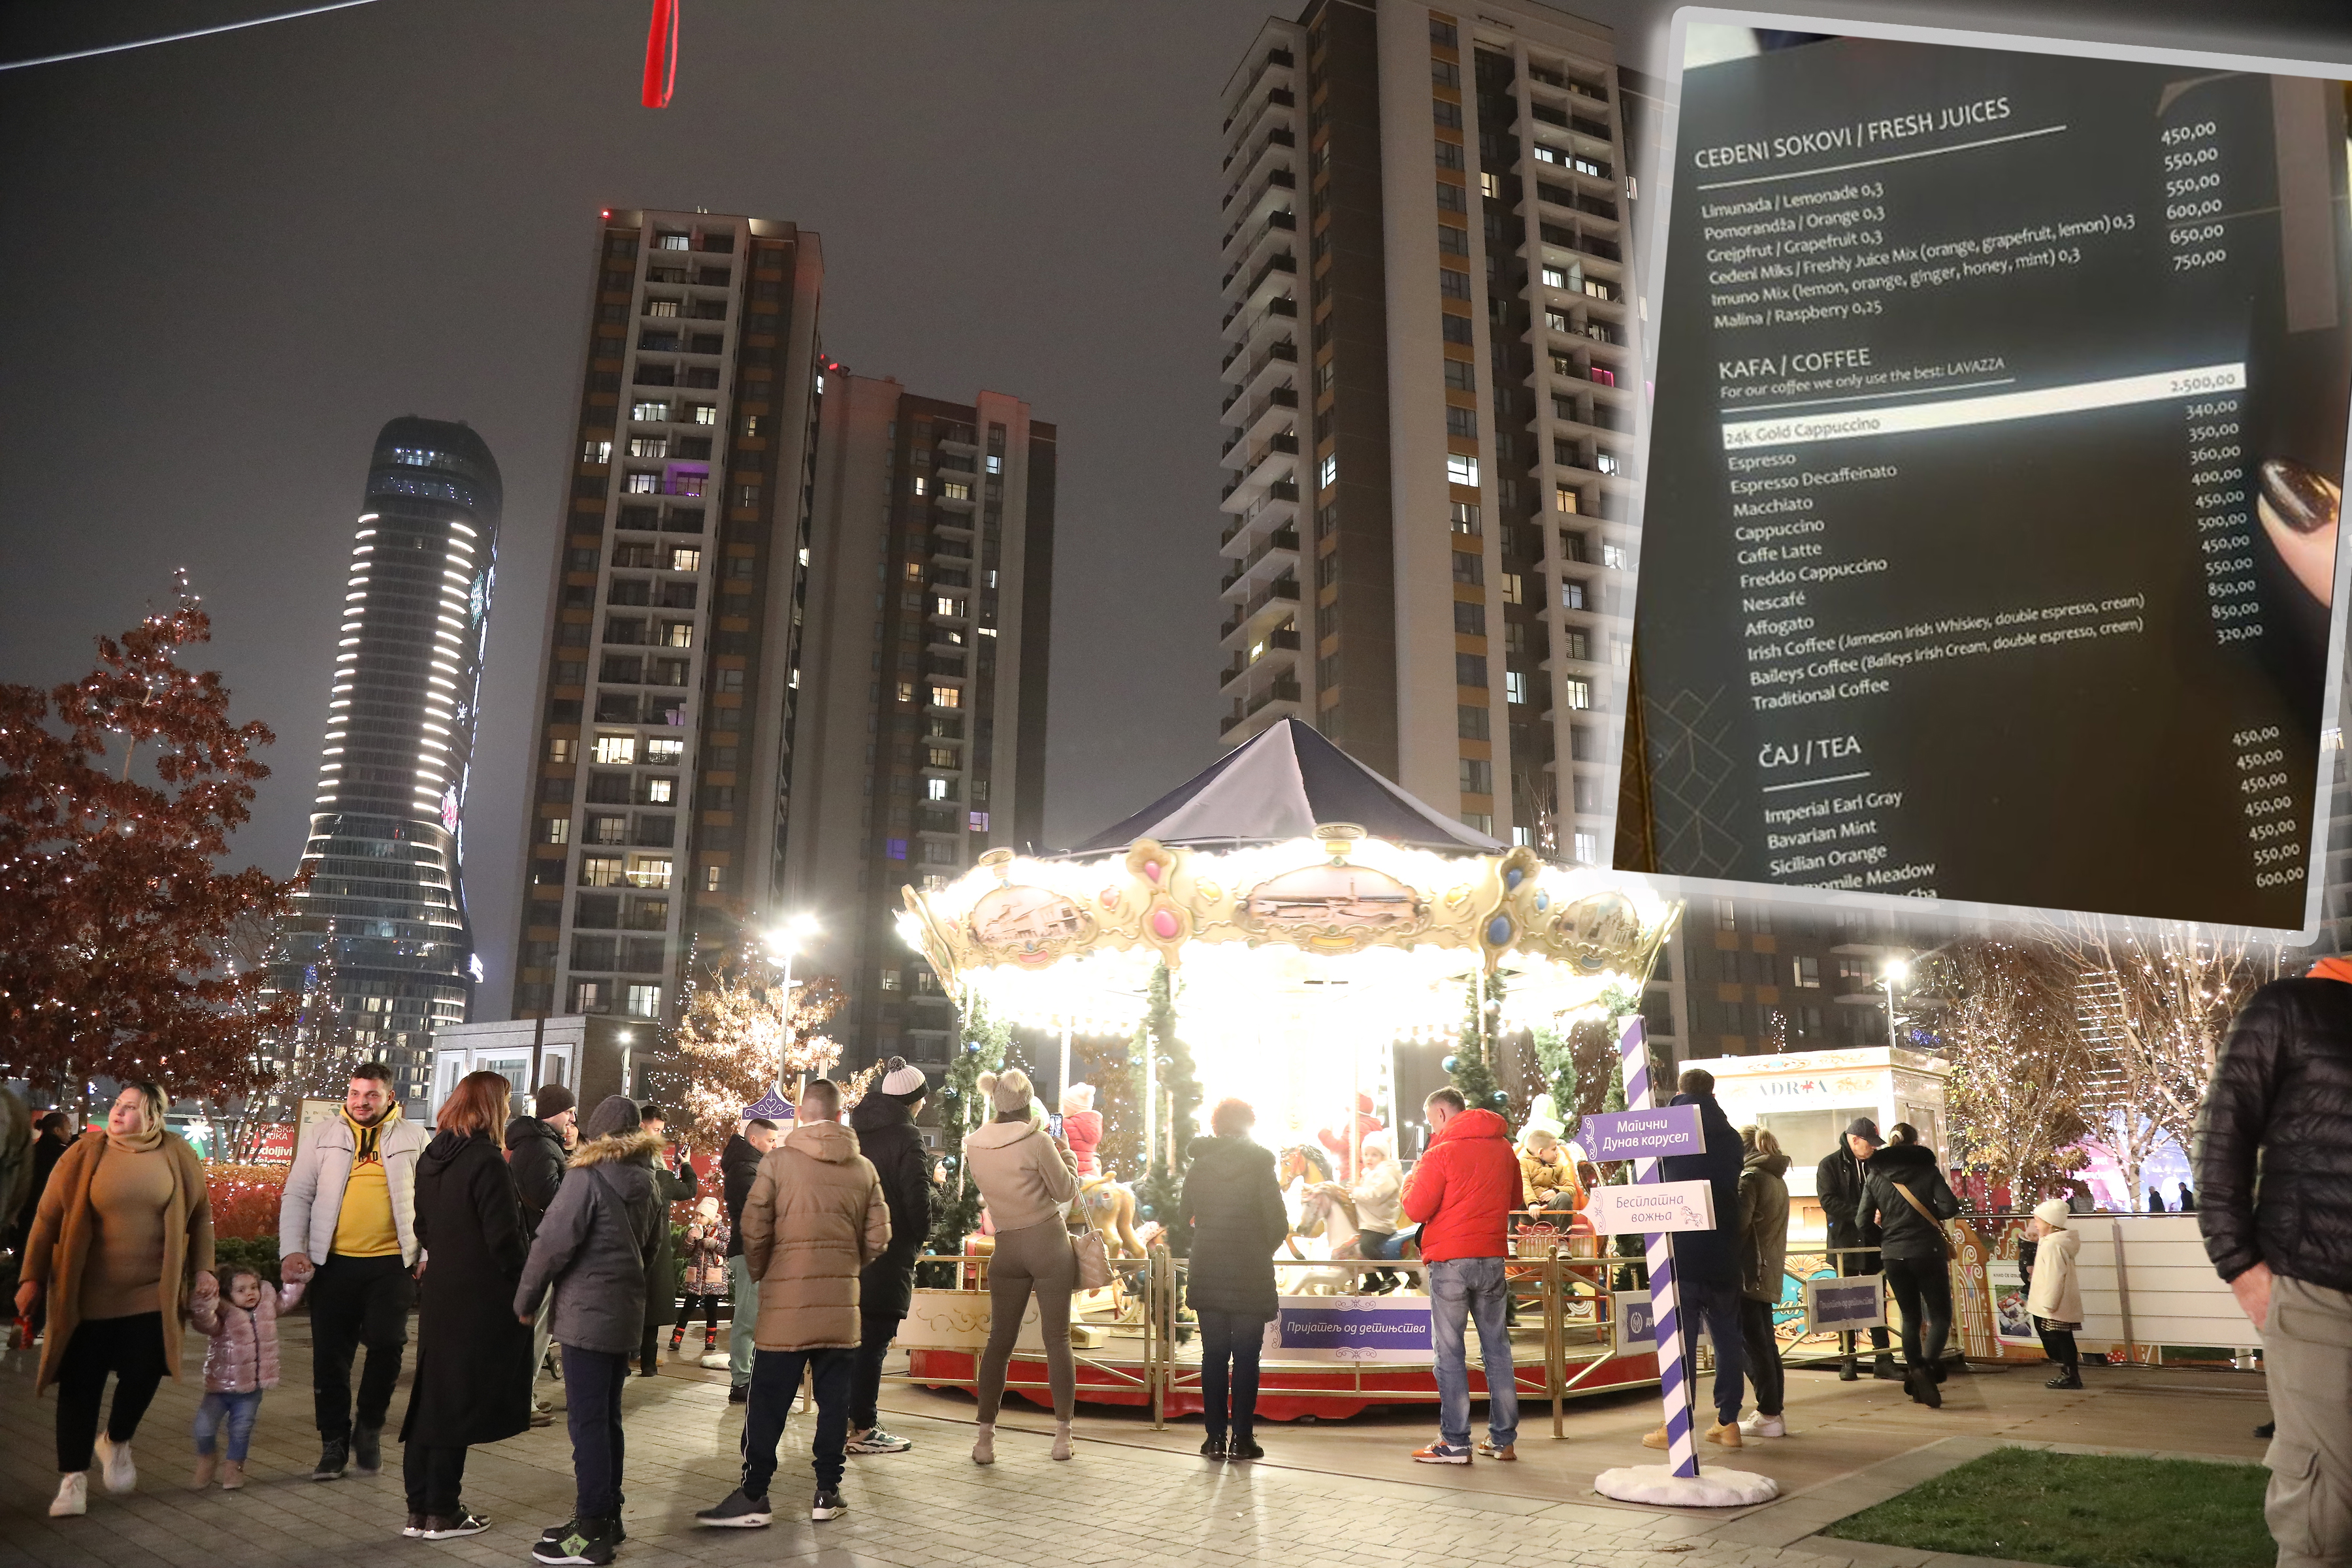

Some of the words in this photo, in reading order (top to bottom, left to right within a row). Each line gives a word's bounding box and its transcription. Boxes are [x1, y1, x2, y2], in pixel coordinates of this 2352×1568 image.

[1695, 142, 1769, 169] CEĐENI
[1775, 127, 1851, 157] SOKOVI
[1868, 112, 1933, 142] FRESH
[1938, 97, 2010, 130] JUICES
[2161, 121, 2216, 145] 450,00
[2164, 147, 2218, 171] 550,00
[2166, 173, 2220, 197] 550,00
[1701, 197, 1772, 218] Limunada
[1783, 185, 1859, 209] Lemonade
[2166, 199, 2222, 220] 600,00
[1806, 211, 1859, 229] Orange
[2170, 224, 2223, 246] 650,00
[1707, 245, 1772, 264] Grejpfrut
[1784, 233, 1857, 255] Grapefruit
[1761, 265, 1793, 280] Miks
[1803, 255, 1852, 275] Freshly
[1855, 249, 1890, 267] Juice
[1893, 247, 1917, 263] Mix
[2059, 215, 2111, 237] lemon)
[2172, 250, 2227, 271] 750,00
[1712, 291, 1759, 306] Imuno
[1763, 285, 1790, 300] Mix
[1852, 274, 1906, 292] orange,
[1910, 267, 1961, 287] ginger,
[1963, 257, 2012, 276] honey,
[2016, 249, 2056, 269] mint)
[1714, 312, 1763, 328] Malina
[1774, 303, 1849, 323] Raspberry
[1719, 358, 1776, 380] KAFA
[1792, 348, 1871, 372] COFFEE
[1720, 385, 1742, 398] For
[1744, 385, 1767, 396] our
[1771, 380, 1810, 395] coffee
[1813, 380, 1833, 390] we
[1835, 374, 1863, 391] only
[1865, 374, 1887, 384] use
[1891, 369, 1911, 382] the
[1947, 357, 2005, 376] LAVAZZA
[2186, 400, 2238, 420] 340,00
[1756, 425, 1791, 442] Gold
[1794, 416, 1880, 440] Cappuccino
[2189, 423, 2239, 443] 350,00
[1727, 453, 1797, 472] Espresso
[2190, 445, 2241, 465] 360,00
[1731, 476, 1799, 496] Espresso
[1802, 465, 1898, 487] Decaffeinato
[2191, 468, 2243, 486] 400,00
[1733, 498, 1813, 517] Macchiato
[2195, 490, 2245, 509] 450,00
[1735, 519, 1825, 542] Cappuccino
[2197, 512, 2247, 532] 500,00
[1737, 547, 1778, 564] Caffe
[1782, 543, 1823, 559] Latte
[2202, 535, 2250, 553] 450,00
[1740, 569, 1796, 588] Freddo
[1799, 558, 1888, 582] Cappuccino
[2205, 557, 2253, 576] 550,00
[1742, 591, 1806, 612] Nescafé
[1744, 616, 1815, 636] Affogato
[1748, 644, 1782, 661] Irish
[1784, 637, 1836, 656] Coffee
[1838, 629, 1903, 651] (Jameson
[1904, 623, 1933, 637] Irish
[1995, 608, 2039, 626] double
[2100, 592, 2145, 611] cream)
[1750, 668, 1805, 686] Baileys
[1808, 659, 1859, 677] Coffee
[1914, 645, 1943, 660] Irish
[1993, 632, 2037, 650] double
[2099, 617, 2143, 635] cream)
[1752, 686, 1835, 710] Traditional
[1838, 678, 1889, 698] Coffee
[2232, 726, 2279, 746] 450,00
[1758, 743, 1798, 768] ČAJ
[1816, 736, 1861, 759] TEA
[2236, 749, 2283, 770] 450,00
[2241, 772, 2287, 793] 450,00
[1765, 800, 1829, 824] Imperial
[1833, 795, 1862, 813] Earl
[1865, 791, 1903, 808] Gray
[2245, 796, 2291, 817] 450,00
[1767, 828, 1837, 849] Bavarian
[1840, 819, 1877, 838] Mint
[2249, 819, 2296, 841] 450,00
[1770, 855, 1825, 876] Sicilian
[1828, 844, 1888, 864] Orange
[2254, 843, 2300, 866] 550,00
[1867, 862, 1936, 886] Meadow
[2257, 866, 2304, 888] 600,00
[1617, 1119, 1668, 1133] Магични
[1603, 1137, 1639, 1152] Дунав
[1641, 1132, 1689, 1147] карусел
[1616, 1194, 1684, 1209] Бесплатна
[1631, 1211, 1672, 1222] вожња
[1287, 1322, 1342, 1334] Пријатељ
[1344, 1324, 1357, 1335] од
[1360, 1323, 1426, 1335] детињства
